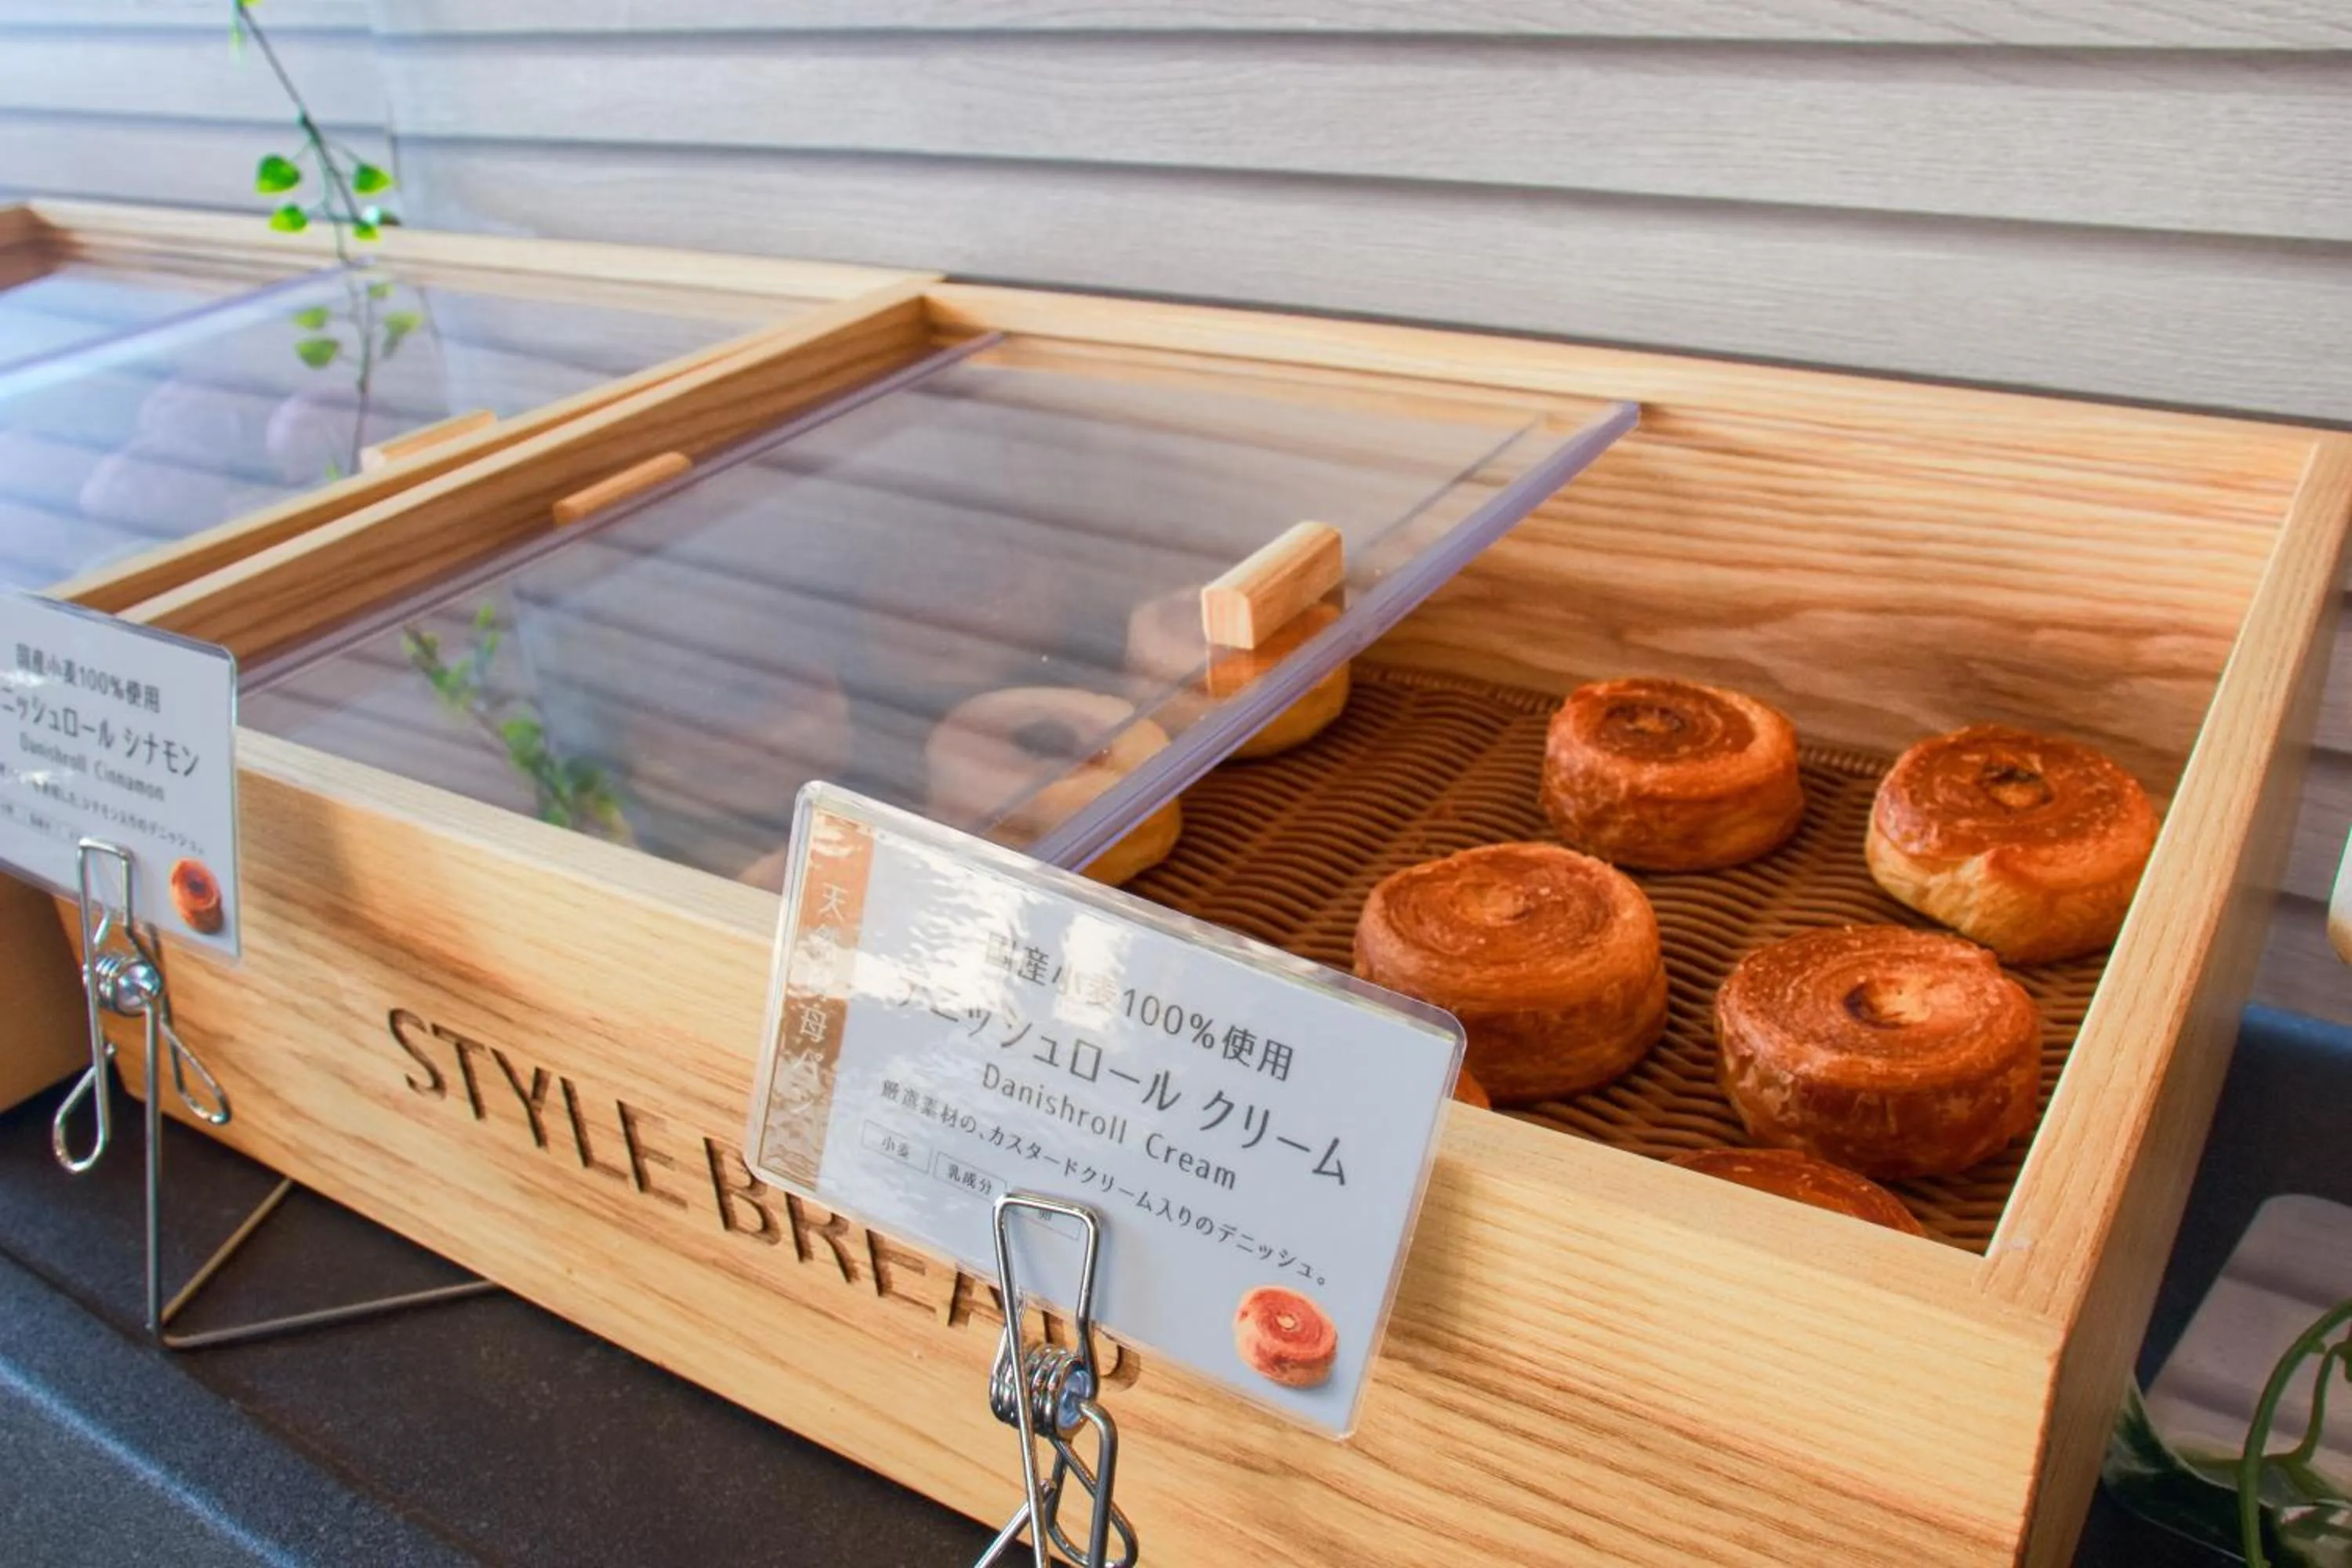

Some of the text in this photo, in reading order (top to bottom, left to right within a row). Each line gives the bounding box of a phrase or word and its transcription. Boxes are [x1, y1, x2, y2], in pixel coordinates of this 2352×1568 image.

[93, 759, 165, 802] Cinnamon
[122, 726, 200, 777] シナモン
[789, 882, 848, 1115] 天母パン
[387, 1007, 689, 1210] STYLE
[982, 1062, 1237, 1191] Danishroll Cream
[1199, 1089, 1347, 1186] クリーム
[947, 1163, 993, 1196] 乳成分
